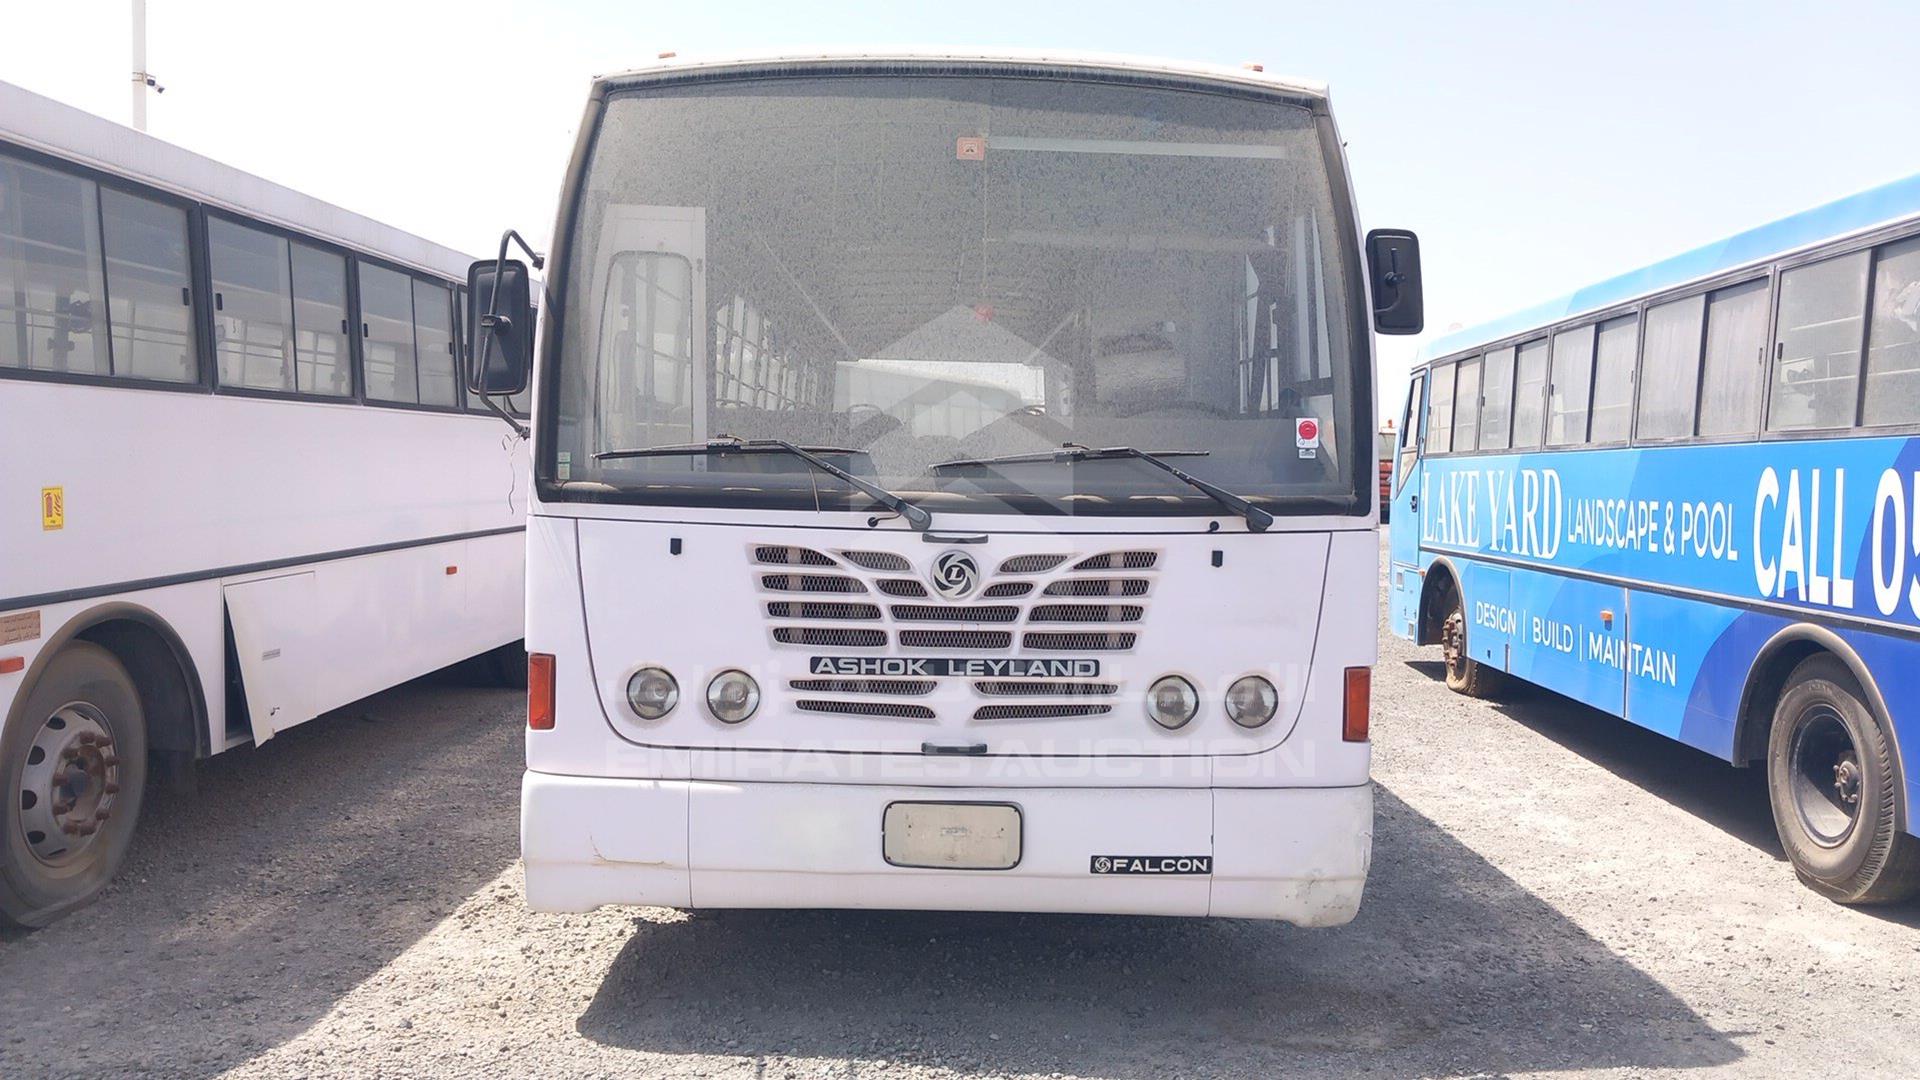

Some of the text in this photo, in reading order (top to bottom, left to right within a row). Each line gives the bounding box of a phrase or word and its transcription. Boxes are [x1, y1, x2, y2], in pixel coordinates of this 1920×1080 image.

[1422, 469, 1563, 560] LAKE YARD
[1567, 498, 1738, 561] LANDSCAPE & POOL
[1753, 466, 1854, 609] CALL
[814, 657, 1097, 677] ASHOK LEYLAND
[1475, 601, 1677, 687] DESIGN BUILD MAINTAIN
[1112, 858, 1208, 873] FALCON
